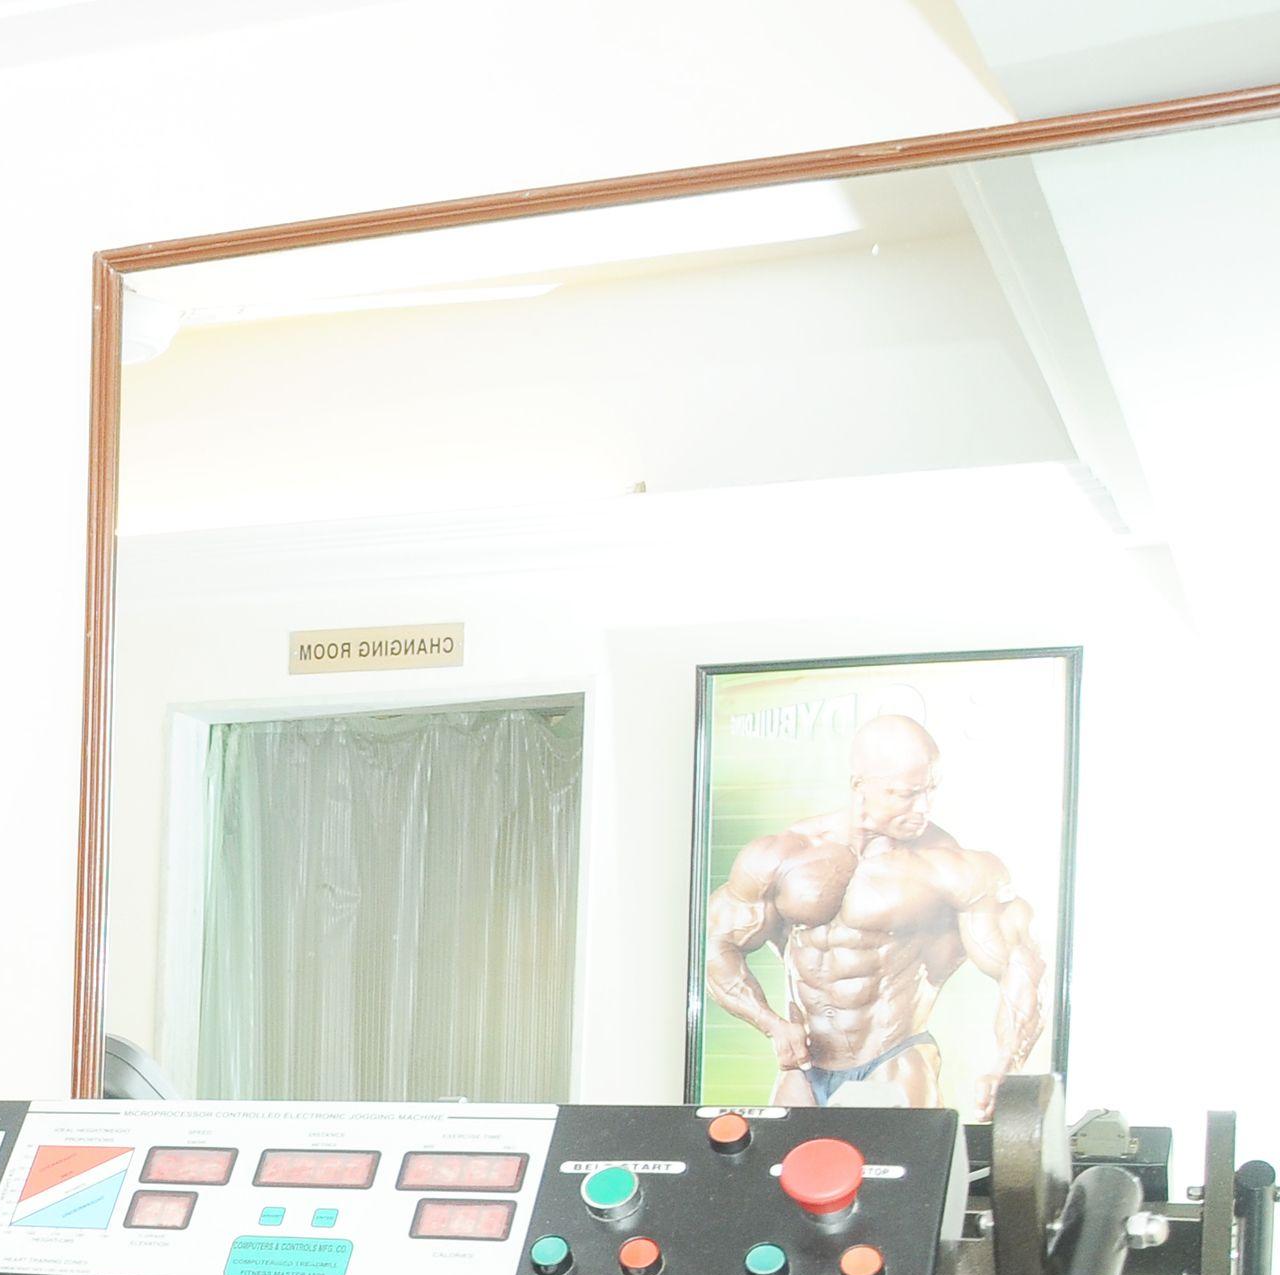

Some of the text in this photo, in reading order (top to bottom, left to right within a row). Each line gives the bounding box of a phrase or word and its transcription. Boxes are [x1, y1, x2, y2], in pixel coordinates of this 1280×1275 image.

[124, 1110, 446, 1121] MICROPROCESSOR CONTROLLED ELECTRONIC JOGGING MACHINE
[233, 1241, 274, 1251] COMPUTERS
[280, 1242, 316, 1252] CONTROLS
